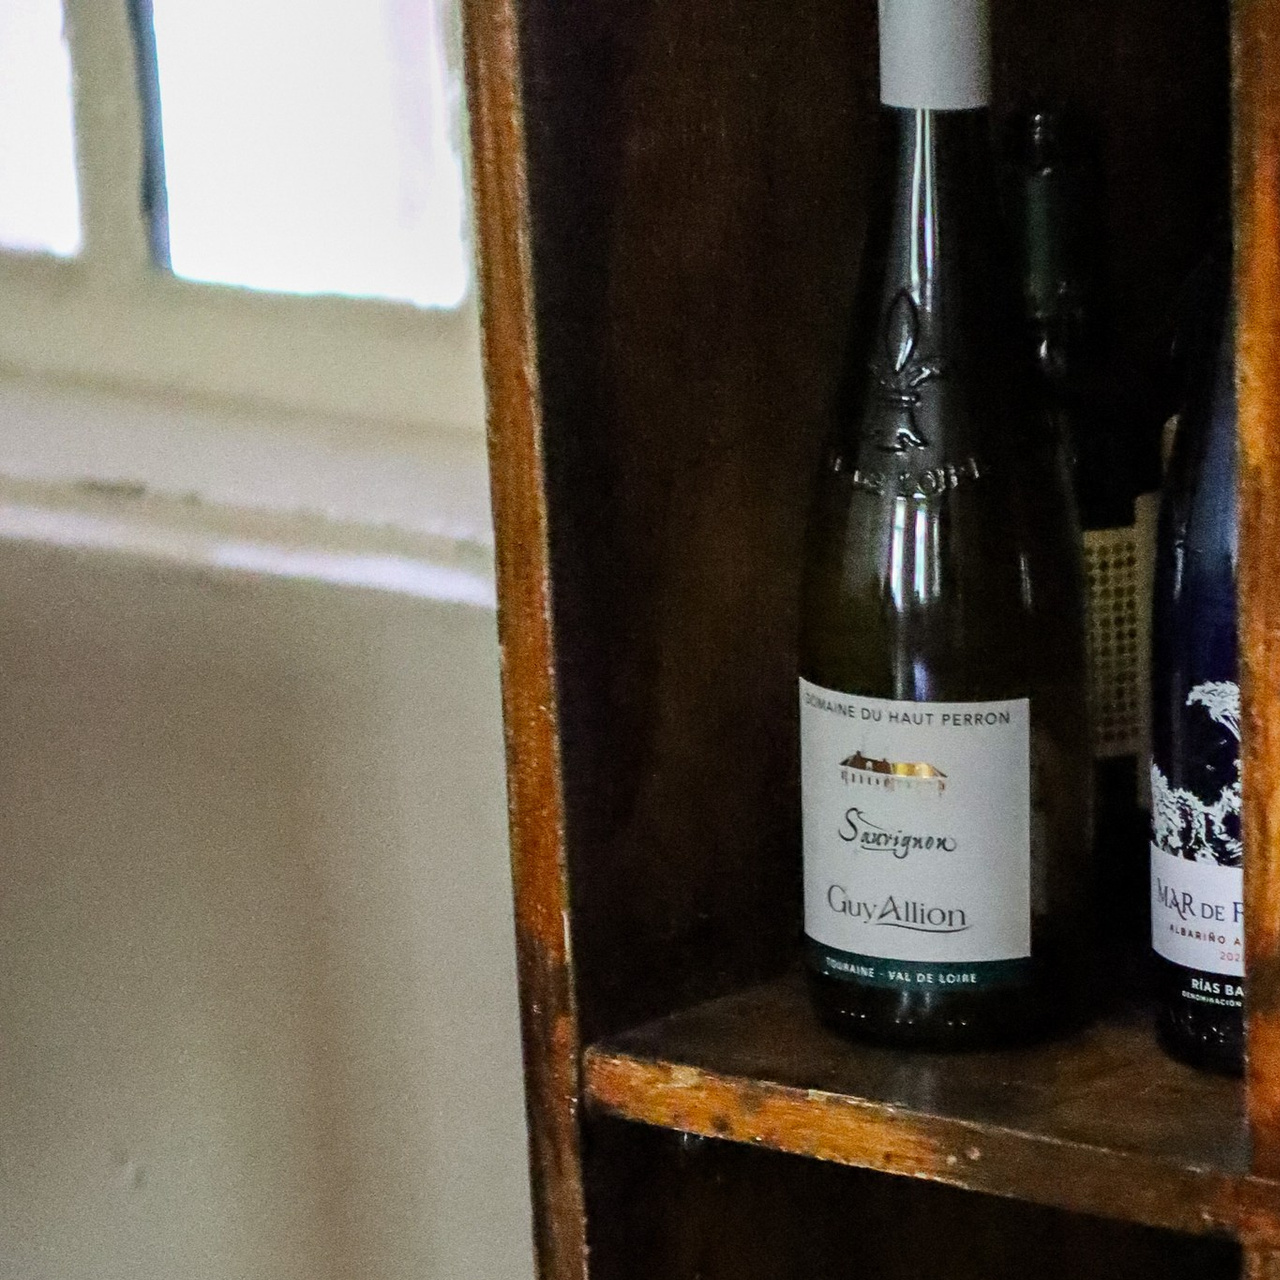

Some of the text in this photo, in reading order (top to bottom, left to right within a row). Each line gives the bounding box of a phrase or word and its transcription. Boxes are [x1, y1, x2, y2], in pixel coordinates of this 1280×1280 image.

[861, 707, 882, 722] DU
[889, 712, 934, 726] HAUT
[942, 711, 1010, 726] PERRON
[838, 807, 957, 859] Sauvignon
[1157, 878, 1244, 922] MAR DE F
[888, 971, 911, 983] VAL
[917, 973, 933, 983] DE
[939, 973, 977, 984] LOIRE
[1225, 984, 1244, 997] BA
